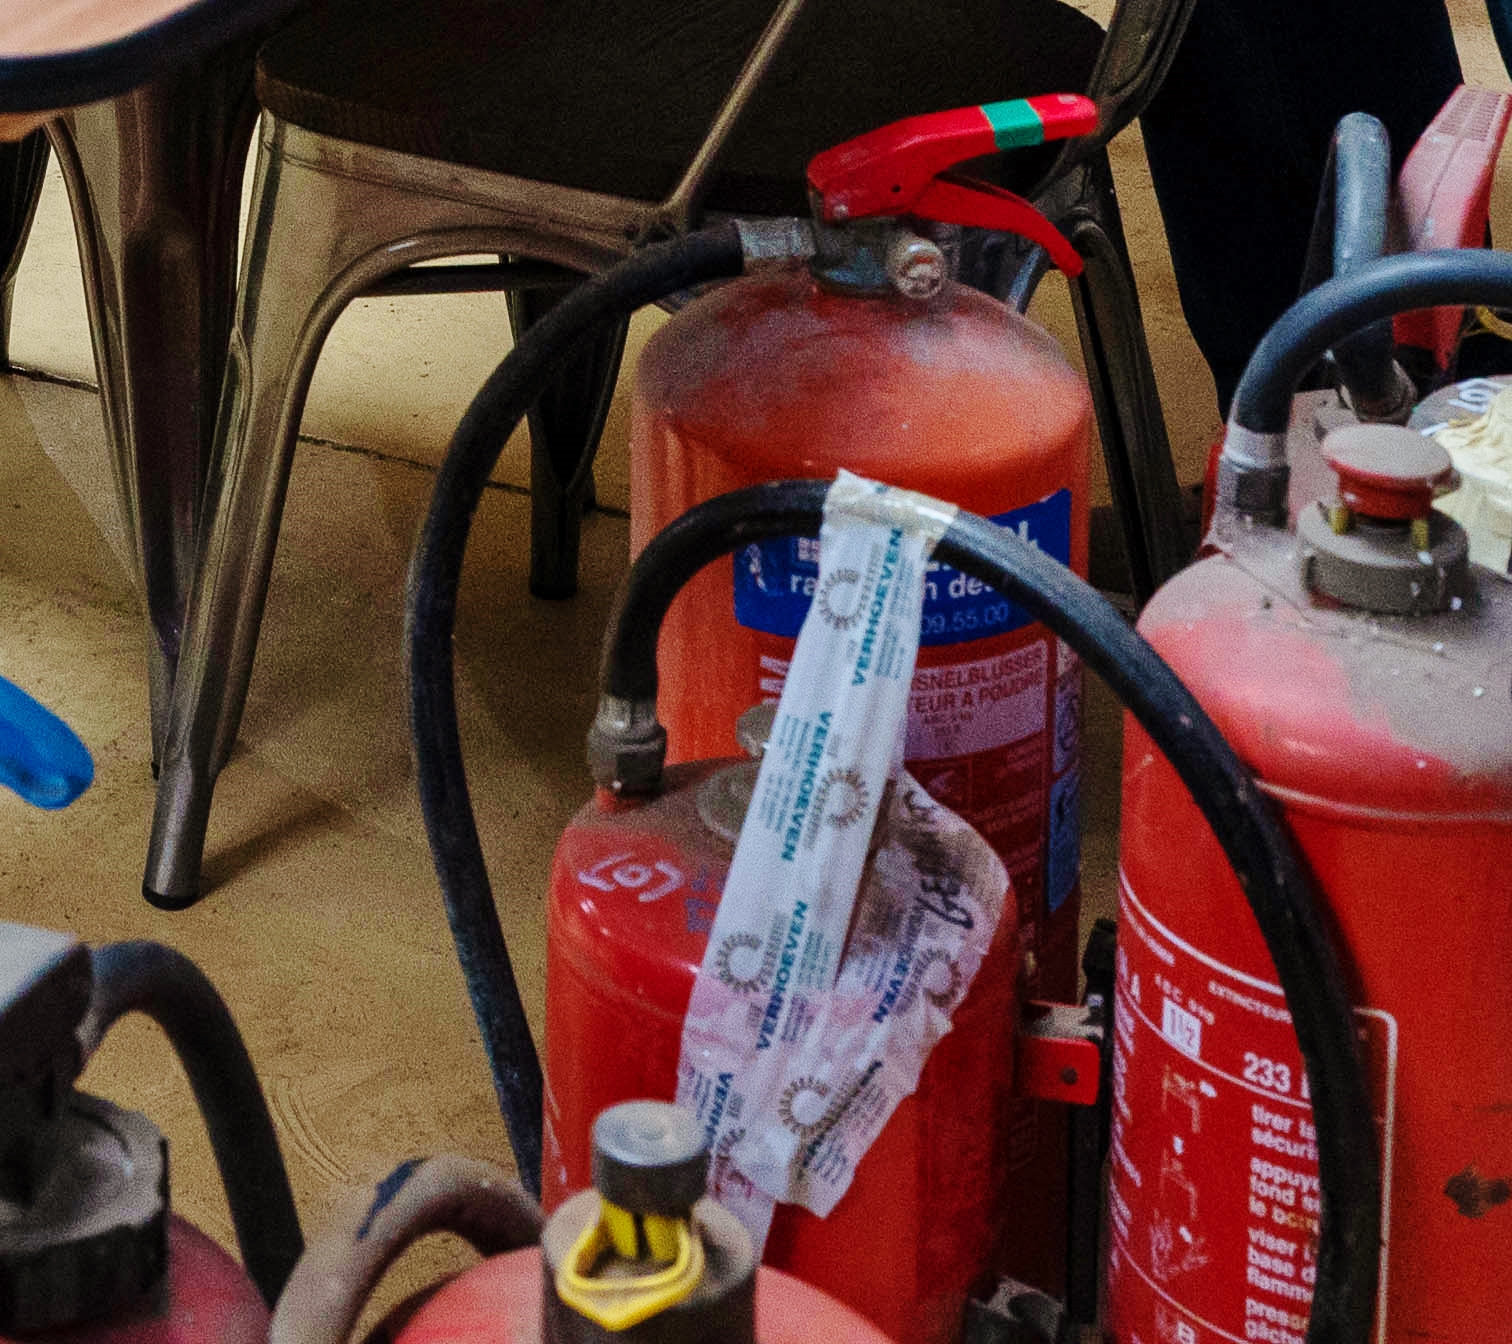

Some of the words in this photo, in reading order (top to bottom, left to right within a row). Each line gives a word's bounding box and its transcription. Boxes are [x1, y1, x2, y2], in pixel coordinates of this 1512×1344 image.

[852, 527, 904, 687] VERHOEVEN
[780, 711, 833, 863] VERHOEVEN
[756, 900, 809, 1052] VERHOEVEN
